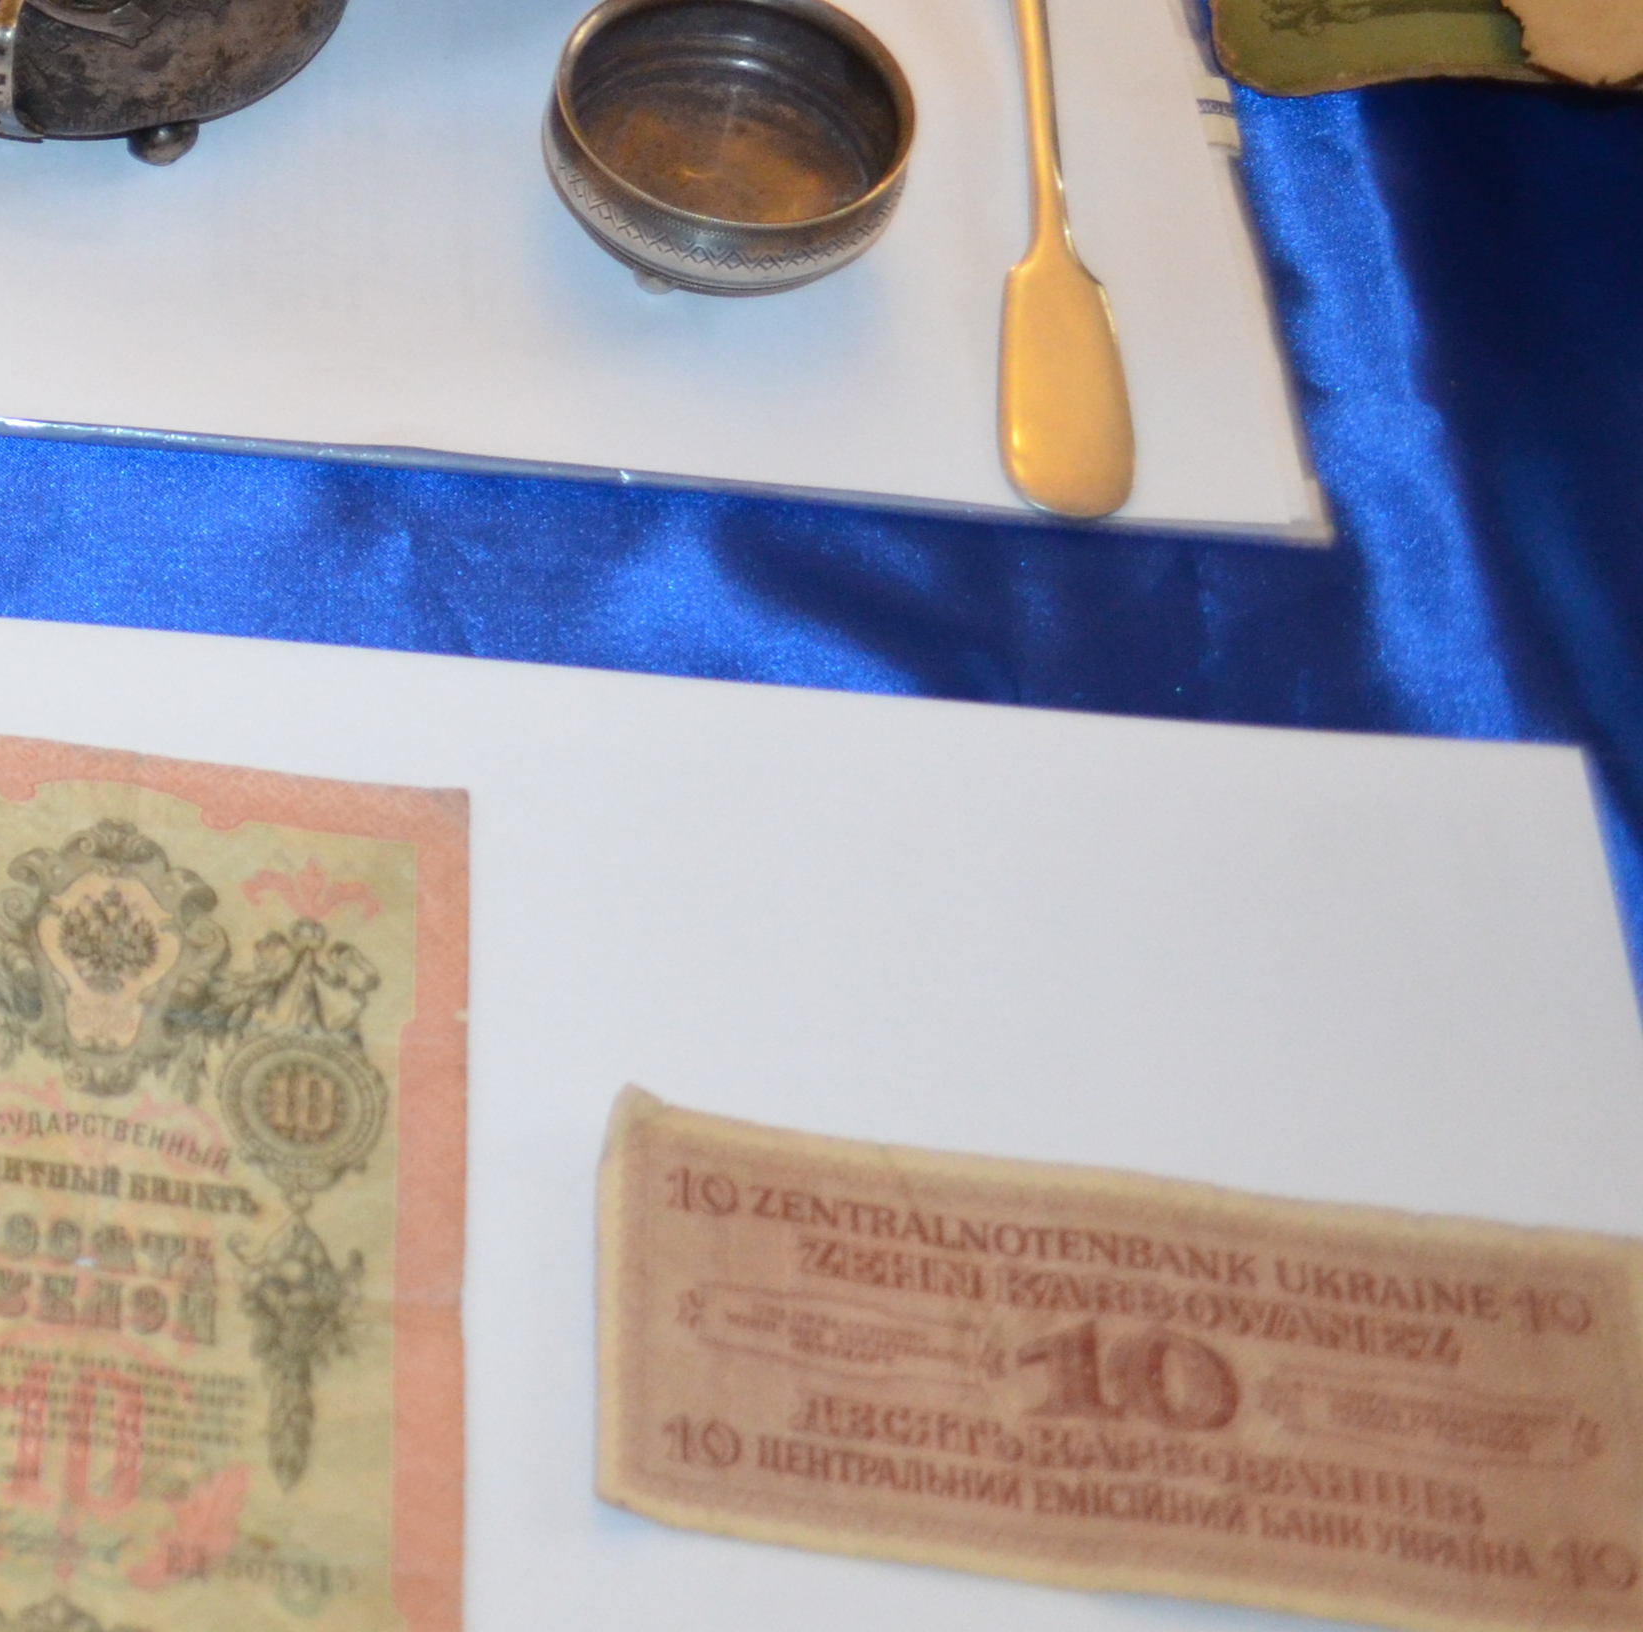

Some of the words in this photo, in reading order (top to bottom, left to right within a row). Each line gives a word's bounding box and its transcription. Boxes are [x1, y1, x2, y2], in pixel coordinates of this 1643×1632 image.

[664, 1166, 740, 1216] 10
[749, 1184, 1259, 1287] ZENTRALNOTENBANK
[1273, 1258, 1502, 1323] UKRAINE
[1017, 1319, 1241, 1432] 10
